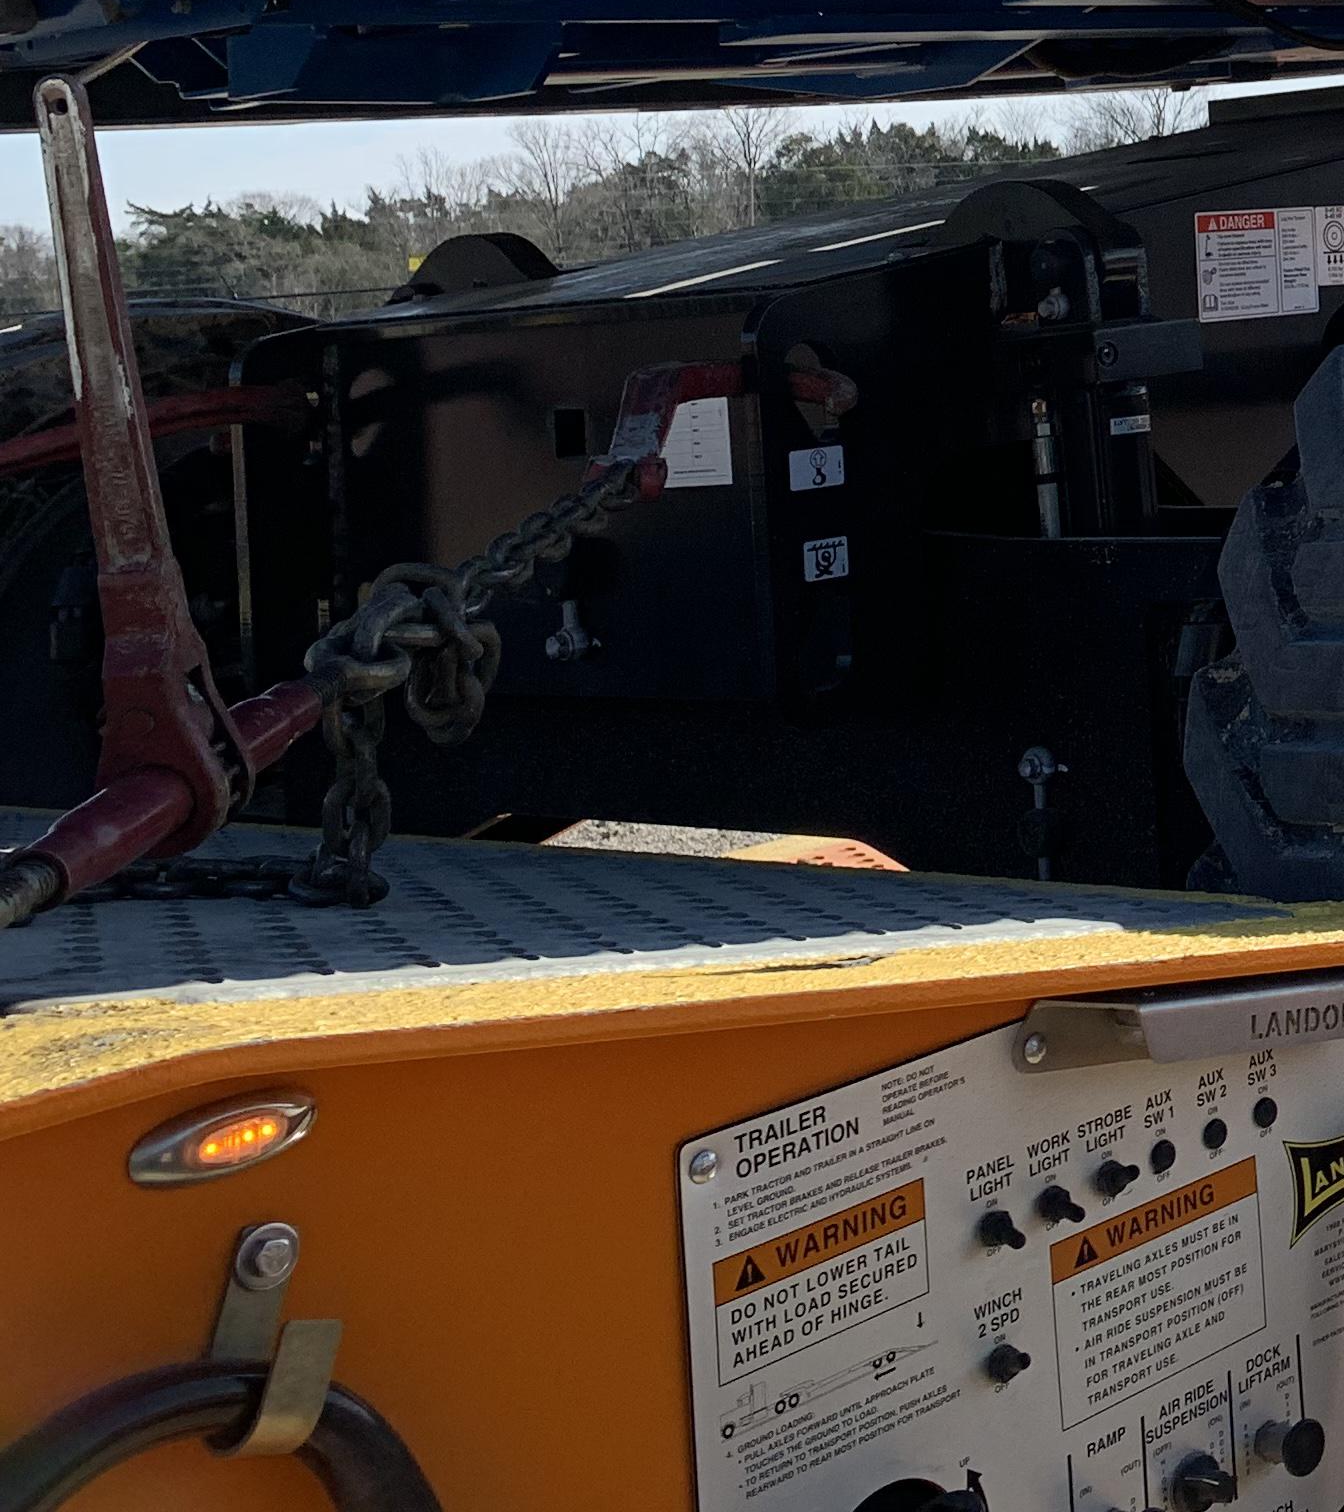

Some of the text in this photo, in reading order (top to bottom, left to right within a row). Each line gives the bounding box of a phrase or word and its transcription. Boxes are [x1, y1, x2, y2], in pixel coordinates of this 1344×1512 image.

[1219, 212, 1265, 230] DANGER
[906, 1072, 917, 1082] DO
[918, 1065, 935, 1079] NOT
[1248, 1064, 1277, 1086] SW 3
[1249, 1049, 1274, 1069] AUX
[882, 1071, 950, 1102] OPERATE BEFORE
[882, 1076, 966, 1114] READING OPERATOR'S
[1198, 1068, 1224, 1090] AUX
[1146, 1089, 1171, 1111] AUX
[1197, 1085, 1227, 1107] SW 2
[734, 1105, 827, 1154] TRAILER
[882, 1109, 915, 1126] MANUAL
[1078, 1105, 1132, 1138] STROBE
[1144, 1106, 1174, 1129] SW 1
[735, 1116, 860, 1178] OPERATION
[1027, 1130, 1070, 1158] WORK
[1086, 1126, 1125, 1152] LIGHT
[966, 1155, 1014, 1184] PANEL
[1029, 1149, 1070, 1177] LIGHT
[970, 1172, 1013, 1201] LIGHT
[776, 1195, 906, 1267] WARNING
[1106, 1184, 1215, 1248] WARNING
[1080, 1214, 1239, 1294] TRAVELING AXLES MUST BE IN
[731, 1238, 910, 1325] DO NOT LOWER TAIL
[1081, 1231, 1241, 1313] THE REAR MOST POSITION FOR
[732, 1254, 917, 1345] WITH LOAD SECURED
[974, 1287, 1022, 1320] WINCH
[1083, 1293, 1146, 1332] TRANSPORT
[1085, 1263, 1247, 1350] AIR RIDE SUSPENSION MUST BE
[733, 1289, 888, 1368] AHEAD OF HINGE.
[979, 1308, 1020, 1338] 2 SPD
[1085, 1283, 1244, 1369] IN TRANSPORT POSITION (OFF)
[1086, 1311, 1225, 1387] FOR TRAVELING AXLE AND
[1246, 1344, 1281, 1373] DOCK
[1088, 1366, 1151, 1406] TRANSPORT
[1238, 1357, 1291, 1394] LIFTARM
[1159, 1379, 1215, 1420] AIR RIDE
[1145, 1390, 1228, 1444] SUSPENSION
[1087, 1427, 1126, 1458] RAMP
